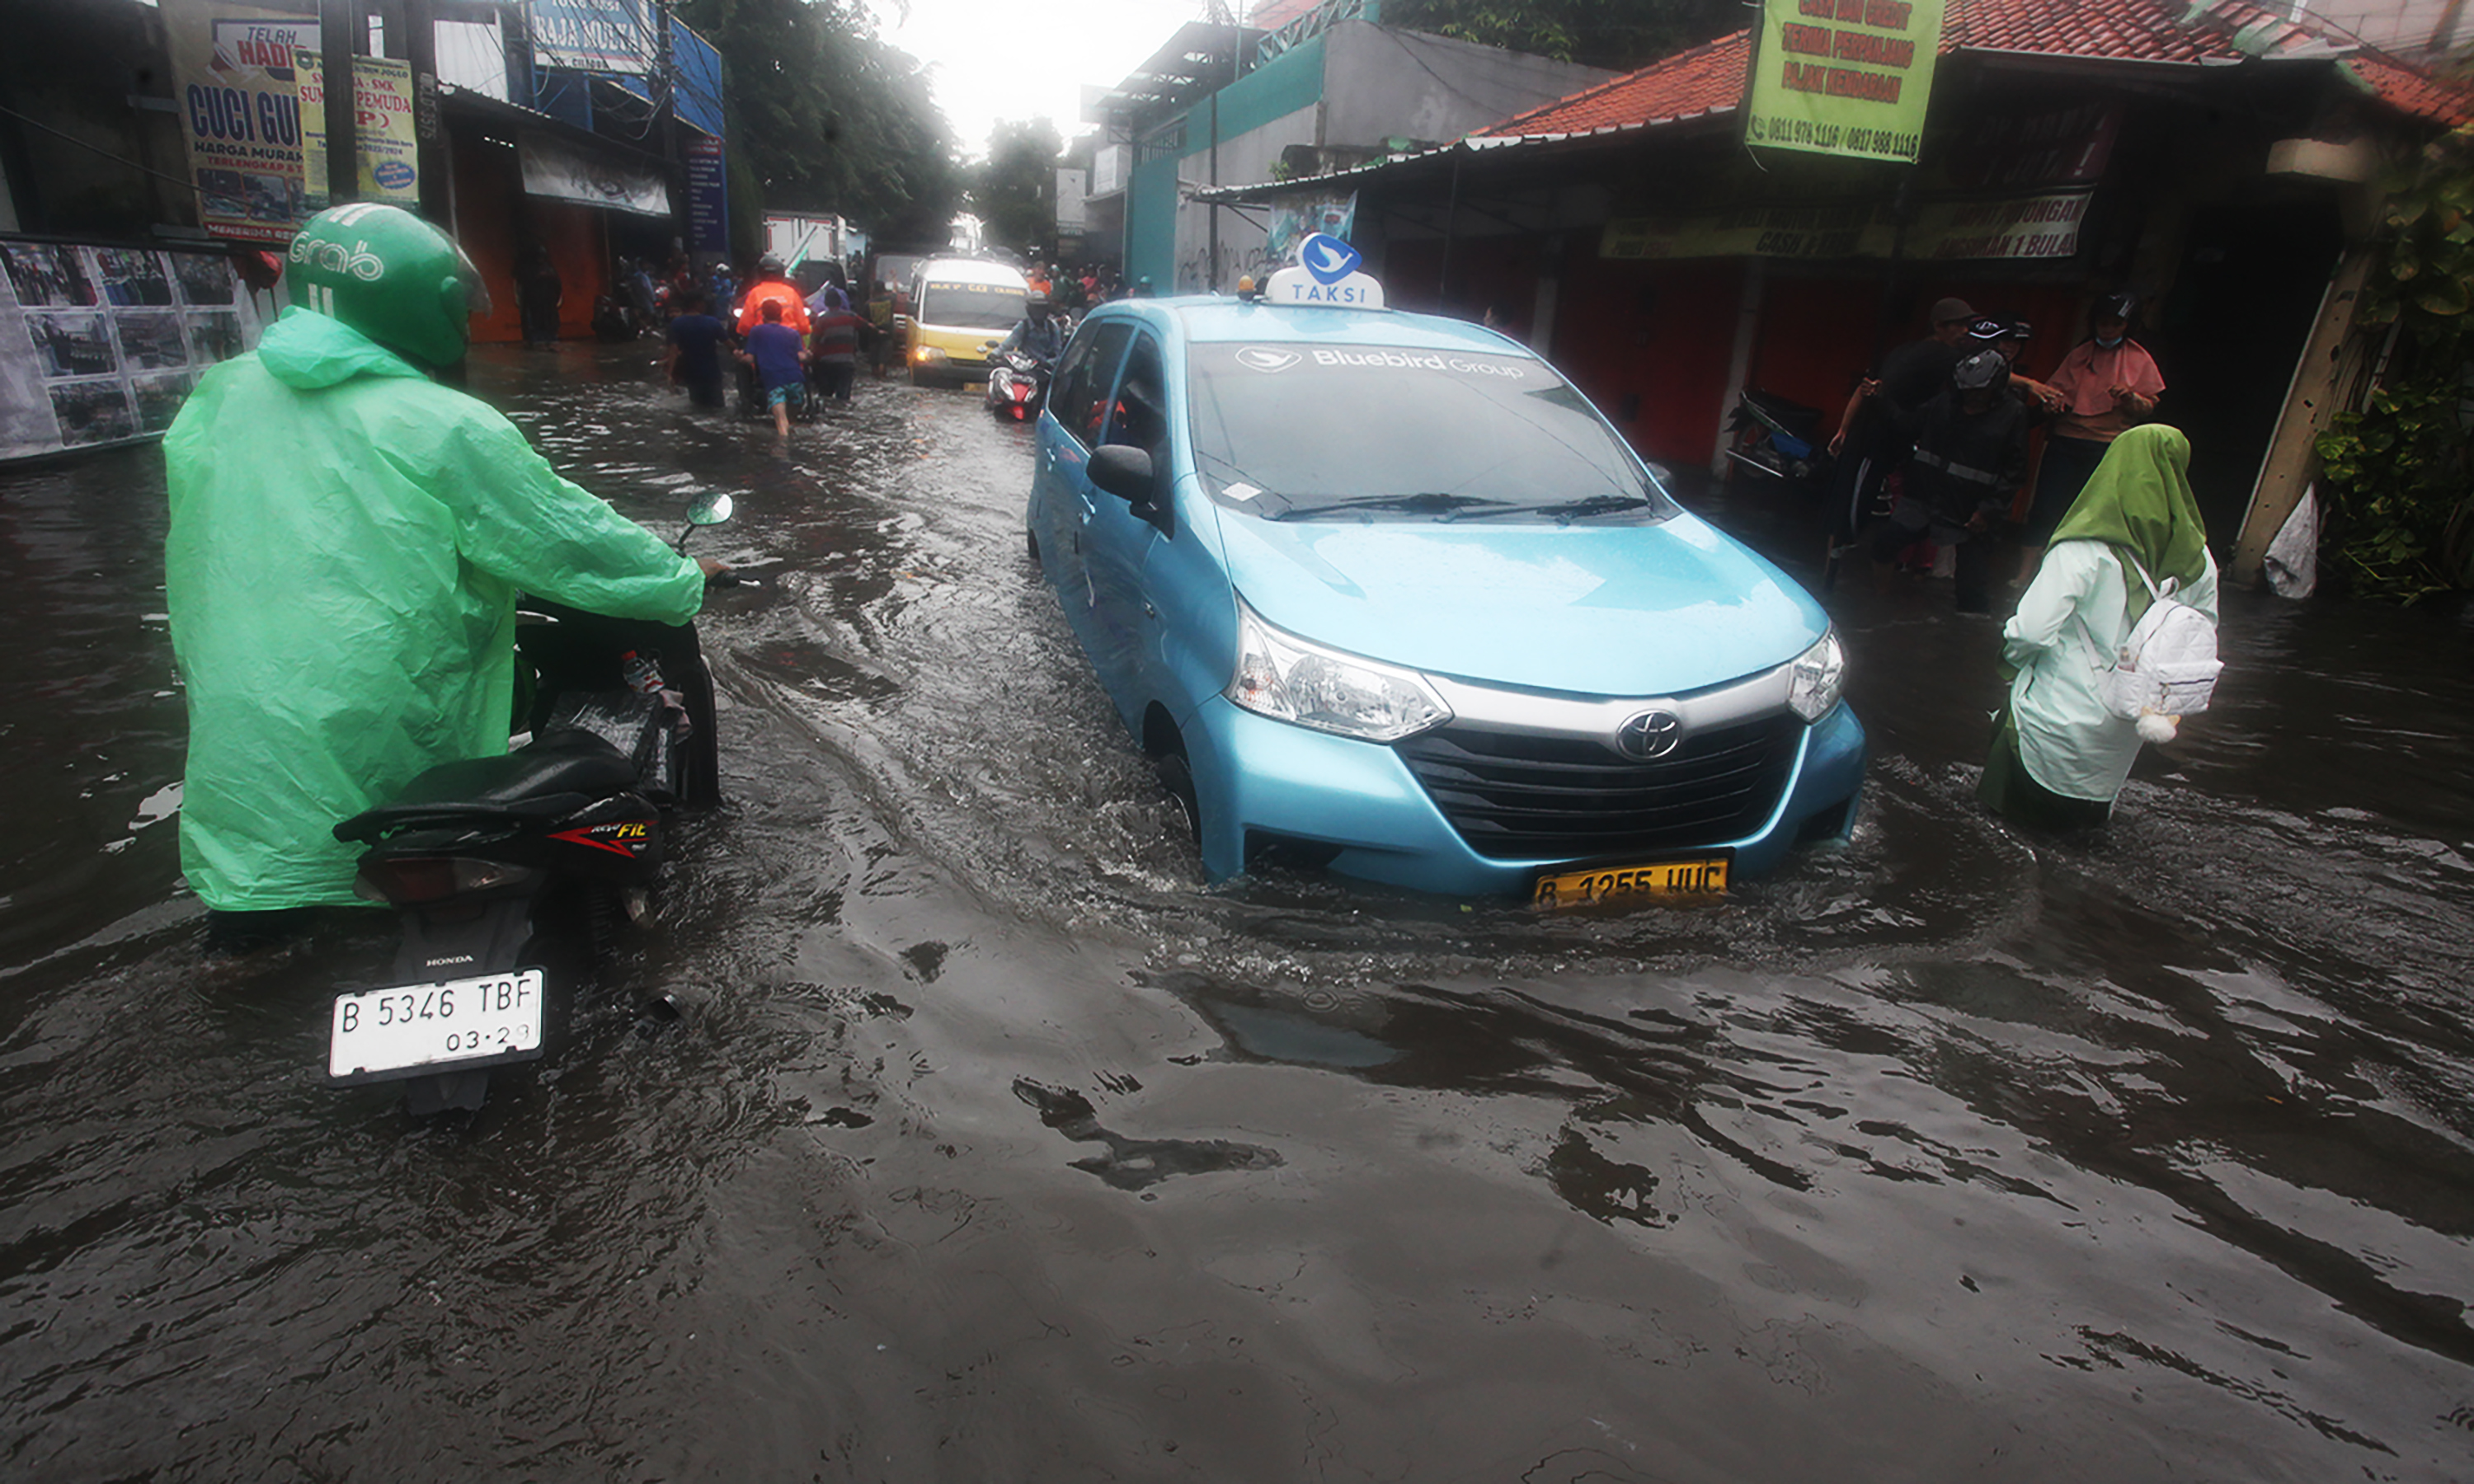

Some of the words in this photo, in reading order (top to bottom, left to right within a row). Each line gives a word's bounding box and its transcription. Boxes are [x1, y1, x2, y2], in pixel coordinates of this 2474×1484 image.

[1865, 0, 1913, 31] CREDIT
[247, 26, 297, 45] TELAH
[1781, 21, 1832, 58] TERIMA
[1832, 30, 1915, 70] PERPANJANG
[1781, 60, 1827, 95] PAJAK
[1825, 67, 1903, 105] KENDARAAN
[186, 83, 256, 142] CUCI
[356, 91, 412, 114] PEMUDA
[194, 141, 249, 157] HARGA
[1769, 116, 1793, 142] 0811
[1794, 120, 1813, 144] 978
[1814, 123, 1840, 148] 1116
[1846, 127, 1872, 152] 0817
[1892, 133, 1919, 157] 1116
[207, 156, 285, 171] TERLENGKAP
[289, 231, 384, 282] Grab
[1756, 230, 1804, 254] CASH
[1292, 284, 1365, 303] TAKSI
[1312, 350, 1447, 370] Bluebird
[1449, 358, 1525, 380] Group
[1539, 881, 1558, 907] B
[1579, 870, 1653, 901] 1255
[426, 955, 473, 967] HONDA
[343, 1002, 360, 1032] B
[379, 989, 455, 1026] 5346
[479, 979, 531, 1012] TBF
